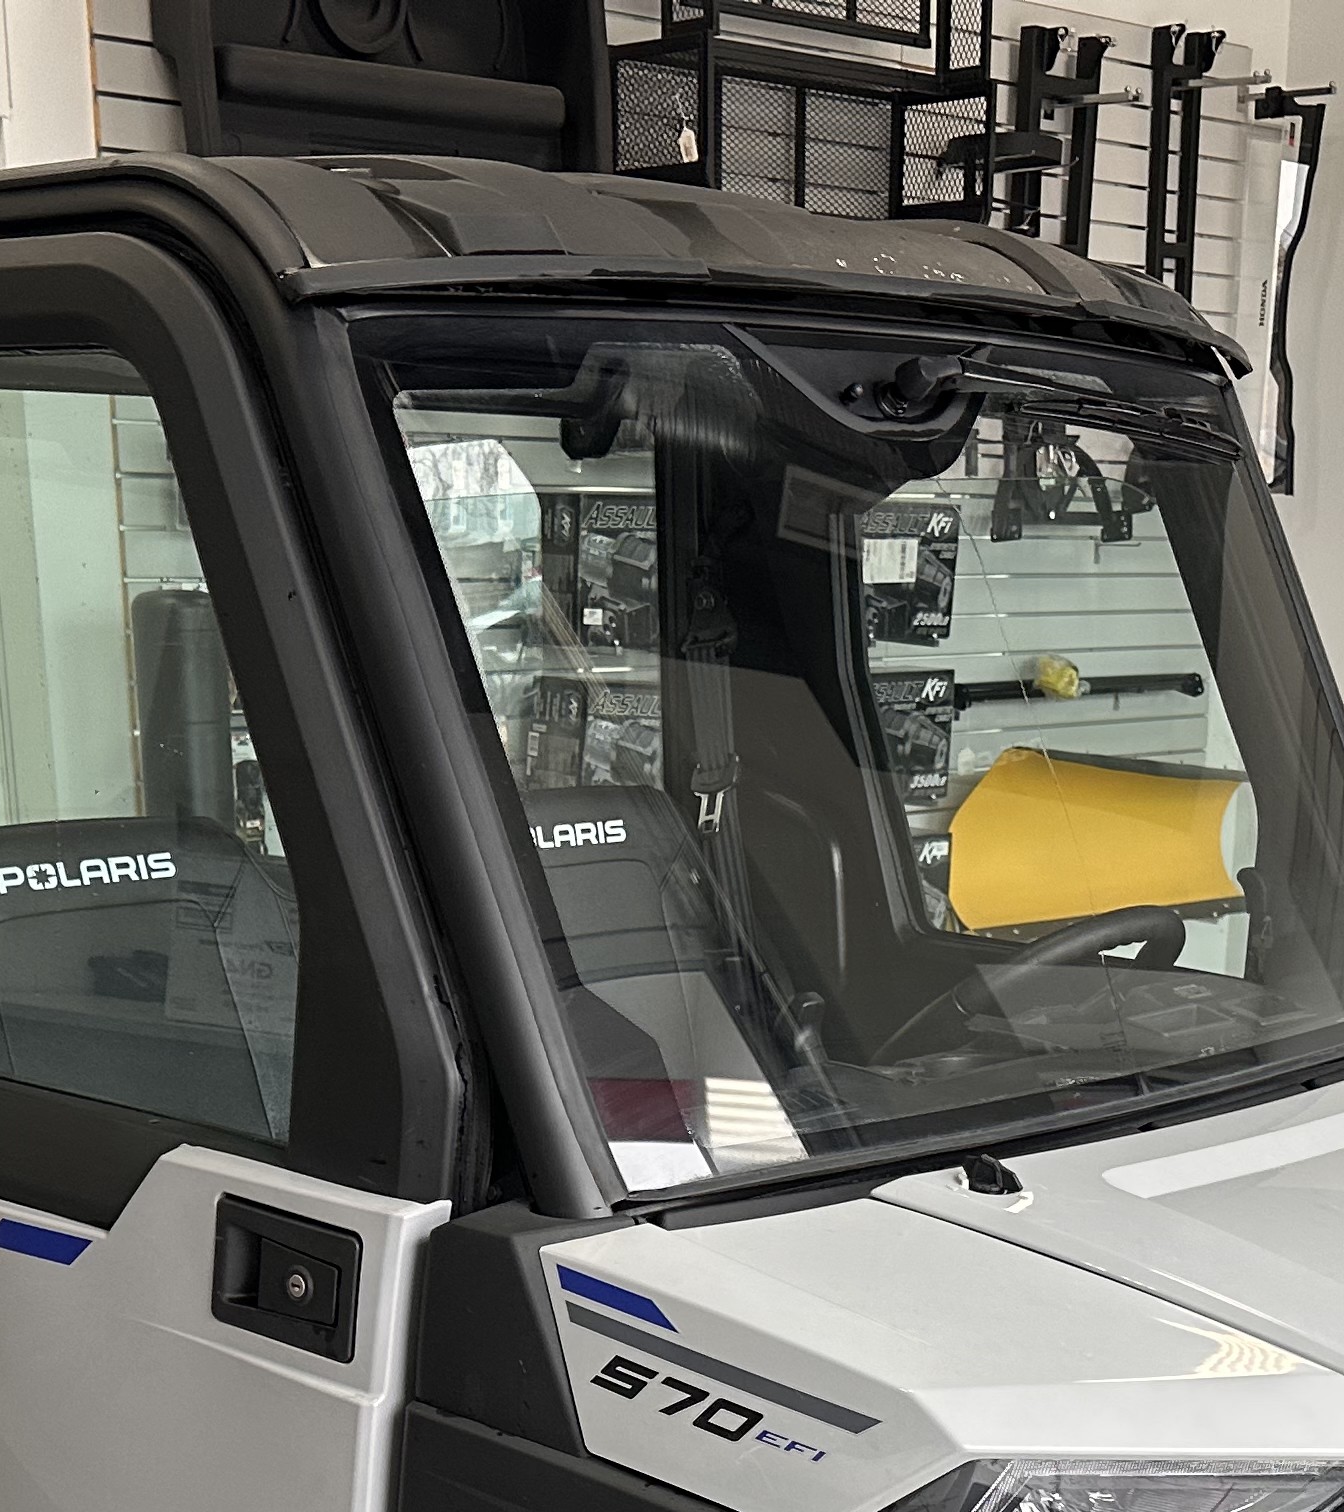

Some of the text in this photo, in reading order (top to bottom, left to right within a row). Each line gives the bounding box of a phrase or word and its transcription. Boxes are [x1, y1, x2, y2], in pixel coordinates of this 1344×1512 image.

[1258, 278, 1268, 328] HONDA
[581, 501, 657, 529] ASSAUL
[588, 689, 662, 717] ASSAUL
[530, 819, 627, 849] LARIS
[589, 1354, 827, 1462] 570 EFI
